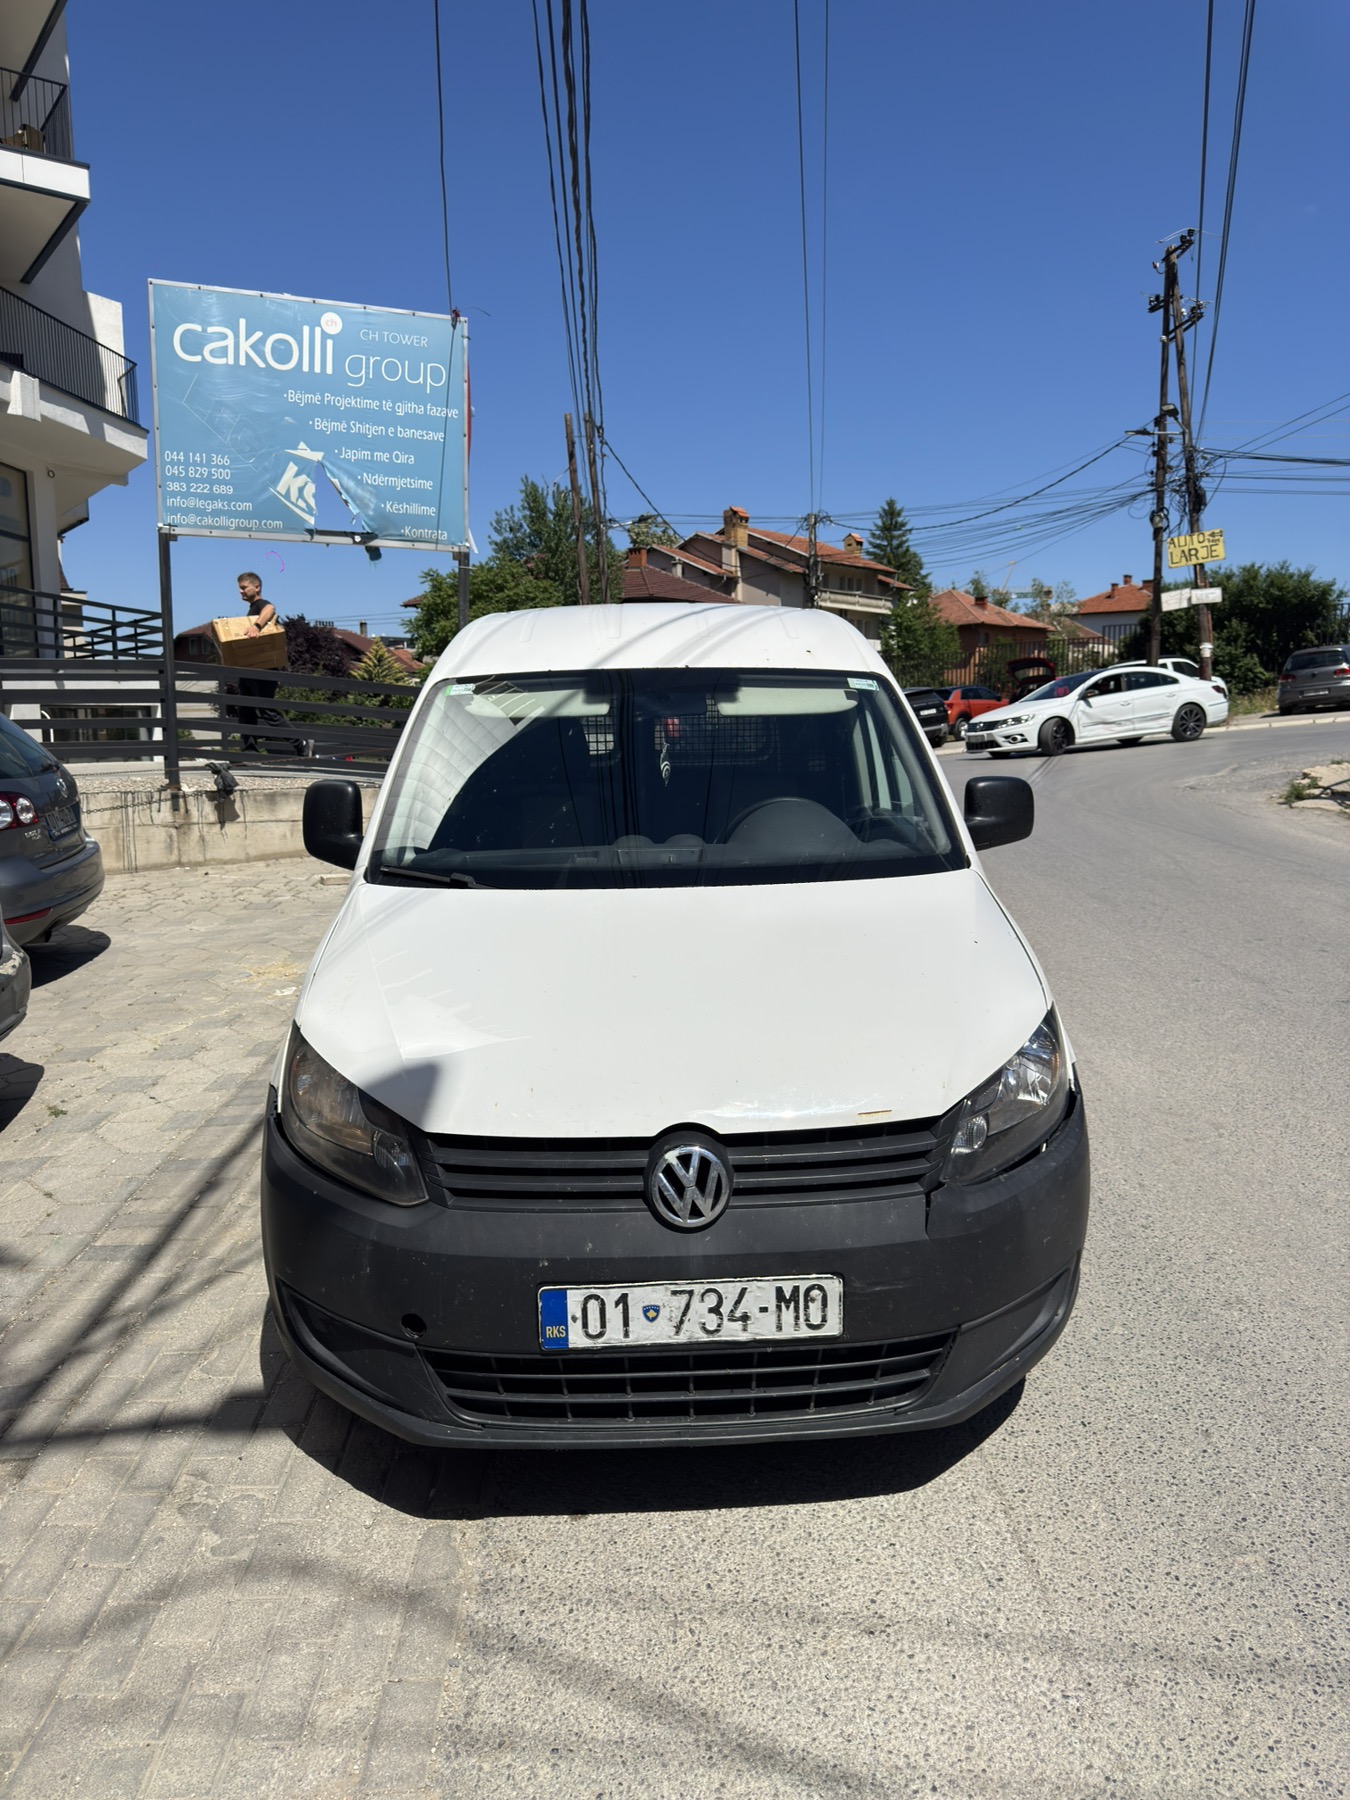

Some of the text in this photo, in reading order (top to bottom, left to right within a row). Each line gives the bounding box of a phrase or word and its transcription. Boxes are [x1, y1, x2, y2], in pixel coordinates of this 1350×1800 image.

[360, 329, 429, 348] CH TOWER
[173, 312, 446, 394] cakolli group
[288, 390, 459, 418] Bëjmë Projektime të gjitha fazave
[314, 418, 445, 442] Bëjmë Shitjen e banesave
[164, 450, 231, 466] 044 141 366
[340, 447, 415, 465] Japim me Qira
[165, 465, 231, 480] 045 829 500
[166, 482, 234, 495] 383 222 689
[363, 473, 433, 490] Ndërmjetsime
[166, 496, 253, 512] info@legaks.com
[386, 501, 436, 516] Këshillime
[167, 513, 283, 530] info@cakolligroup.com
[404, 526, 448, 541] Kontrata
[1168, 532, 1206, 549] AUTO
[1170, 543, 1220, 565] LARJE
[581, 1293, 631, 1341] 01
[545, 1326, 566, 1338] RKS
